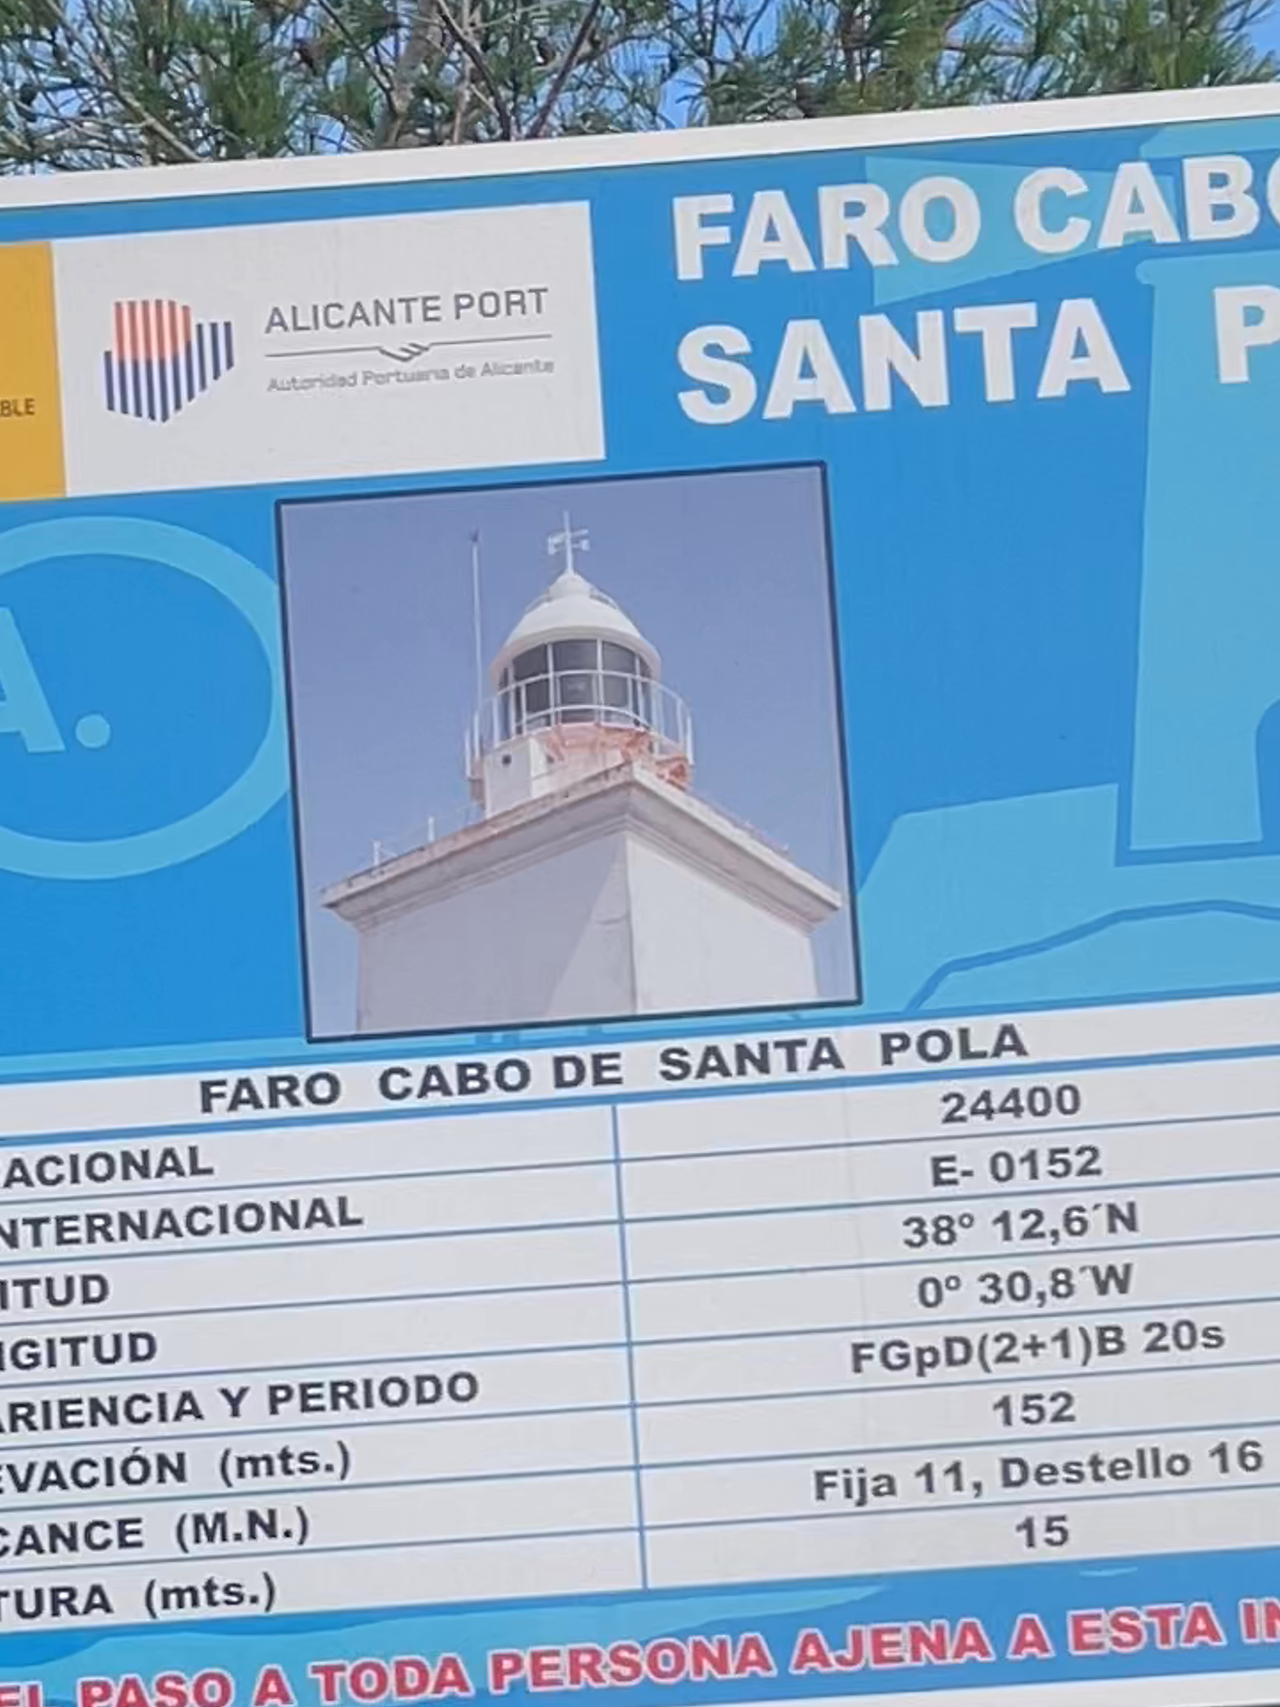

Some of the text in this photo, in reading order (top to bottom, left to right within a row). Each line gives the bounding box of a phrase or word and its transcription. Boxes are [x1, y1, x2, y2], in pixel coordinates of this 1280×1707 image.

[671, 174, 983, 283] FARO
[264, 287, 548, 334] ALICANTE PORT
[267, 359, 554, 392] Autoridad Portuaria de Alicante
[675, 296, 1131, 426] SANTA
[198, 1023, 1027, 1115] FARO CABO DE SANTA POLA
[940, 1084, 1081, 1124] 24400
[931, 1145, 1102, 1187] E- 0152
[851, 1320, 1225, 1376] FGpD(2+1)B 20s
[217, 1385, 249, 1419] Y
[267, 1371, 478, 1416] PERIODO
[992, 1392, 1076, 1428] 152
[218, 1442, 351, 1489] (mts.)
[813, 1441, 1264, 1507] Fija 11, Destello 16
[175, 1507, 310, 1552] (M.N.)
[1014, 1515, 1070, 1550] 15
[143, 1572, 277, 1618] (mts.)
[311, 1655, 470, 1703] TODA
[489, 1632, 773, 1693] PERSONA
[790, 1620, 990, 1672] AJENA
[1008, 1618, 1051, 1659] A
[1069, 1603, 1223, 1652] ESTA
